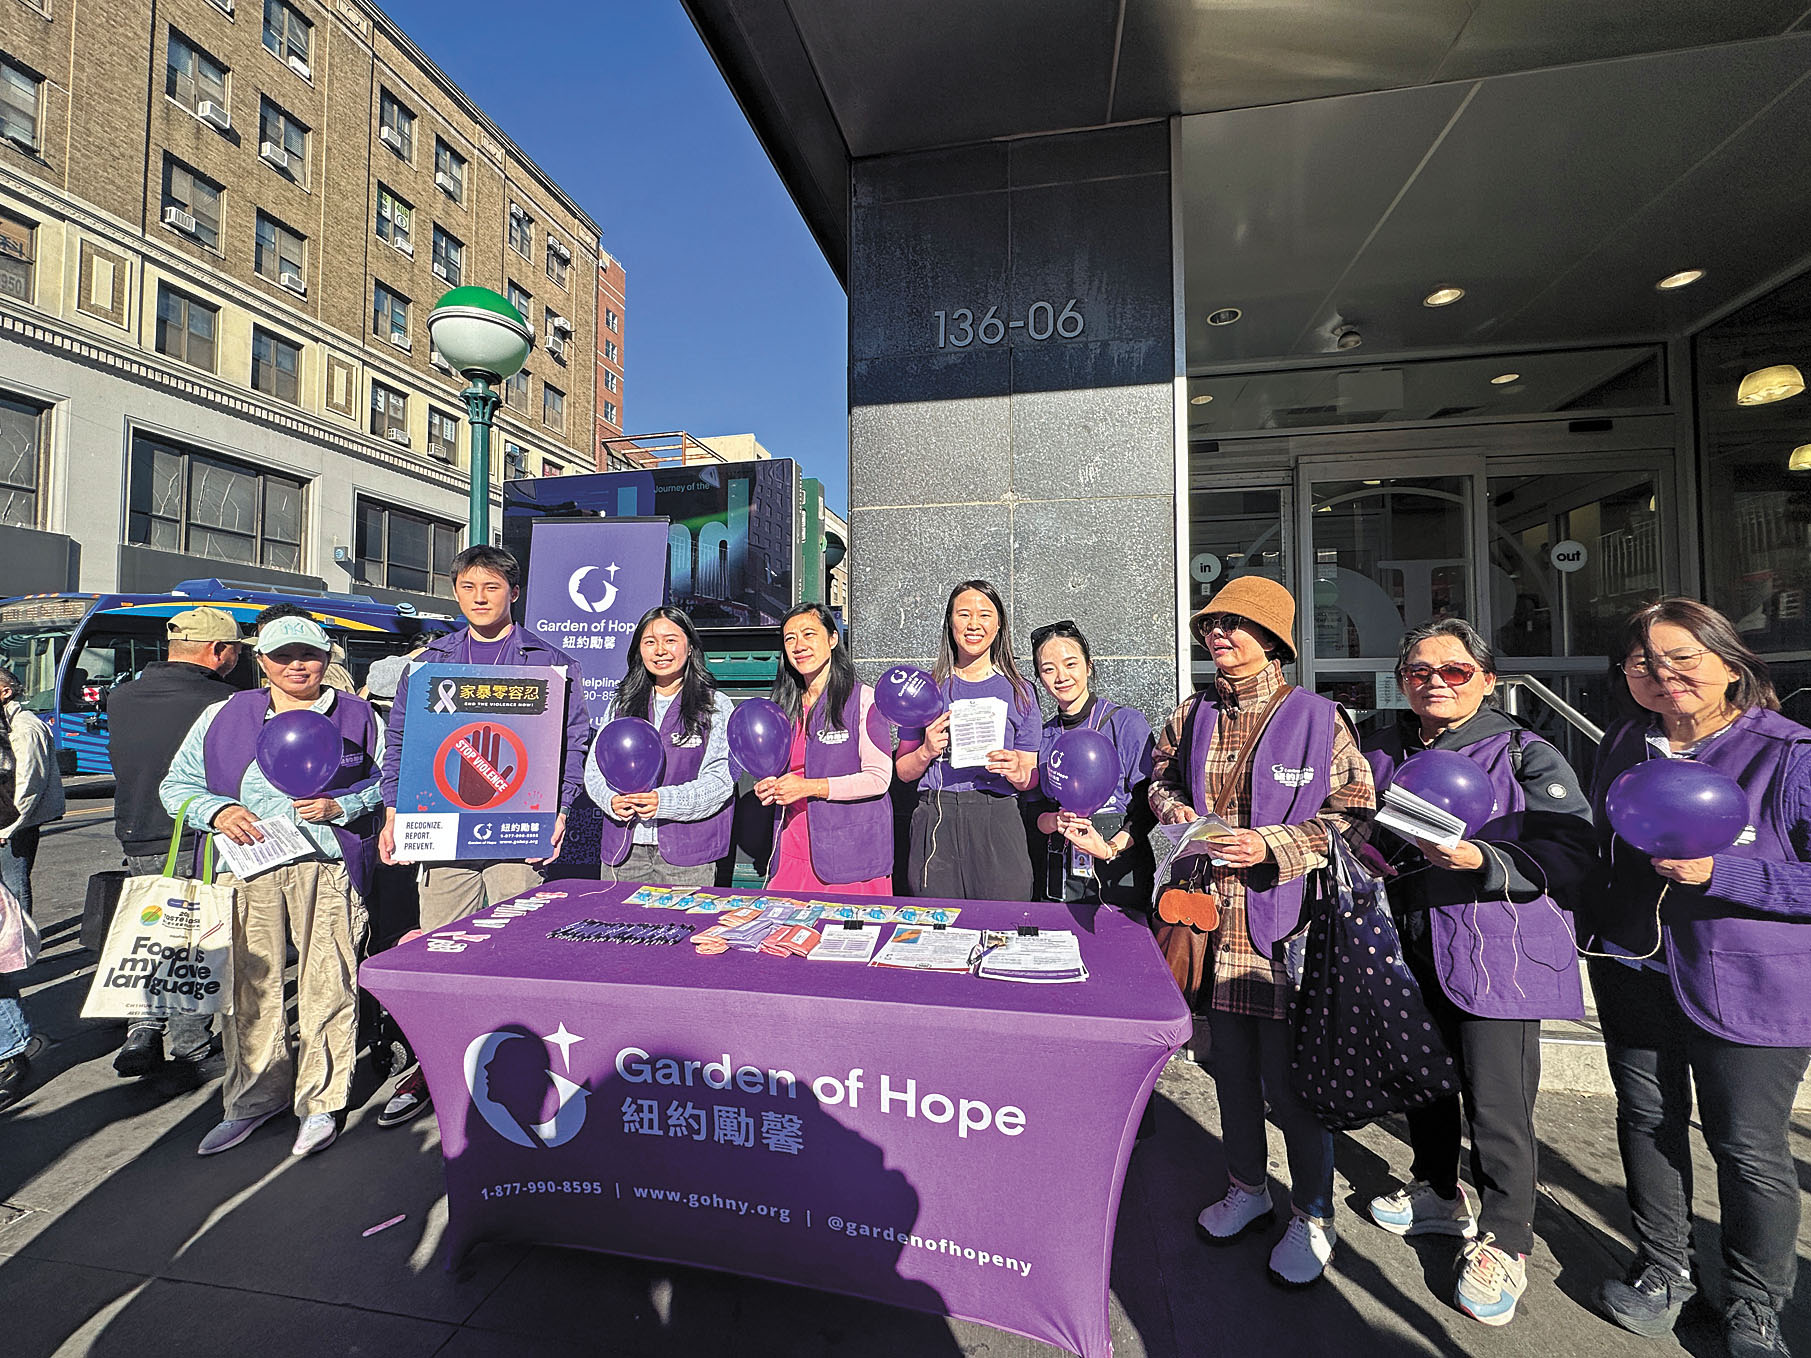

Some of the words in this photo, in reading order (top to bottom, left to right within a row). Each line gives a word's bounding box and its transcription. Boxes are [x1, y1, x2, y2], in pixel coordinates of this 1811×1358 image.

[934, 299, 1084, 348] 136-06
[654, 484, 685, 493] Journey
[687, 482, 695, 491] of
[696, 481, 710, 490] the
[1556, 550, 1581, 561] out
[1200, 562, 1212, 573] in
[536, 619, 588, 632] Garden
[591, 619, 606, 632] of
[608, 619, 638, 635] Hop
[459, 685, 540, 700] 家暴零容忍
[455, 740, 477, 759] STOP
[472, 756, 508, 792] VIOLENCE
[404, 831, 432, 840] REPORT.
[406, 821, 443, 830] RECOGNIZE.
[403, 842, 435, 851] PREVENT.
[131, 936, 191, 962] Food
[118, 957, 162, 981] my
[167, 958, 211, 980] love
[103, 967, 221, 1000] language
[615, 1046, 797, 1098] Garden
[811, 1068, 864, 1108] of
[880, 1074, 1027, 1138] Hope
[621, 1096, 804, 1155] 紐約勵馨
[481, 1180, 602, 1200] 1-877-990-8595
[633, 1186, 791, 1223] www.gohny.org
[827, 1215, 1033, 1277] @gardenofhopeny
